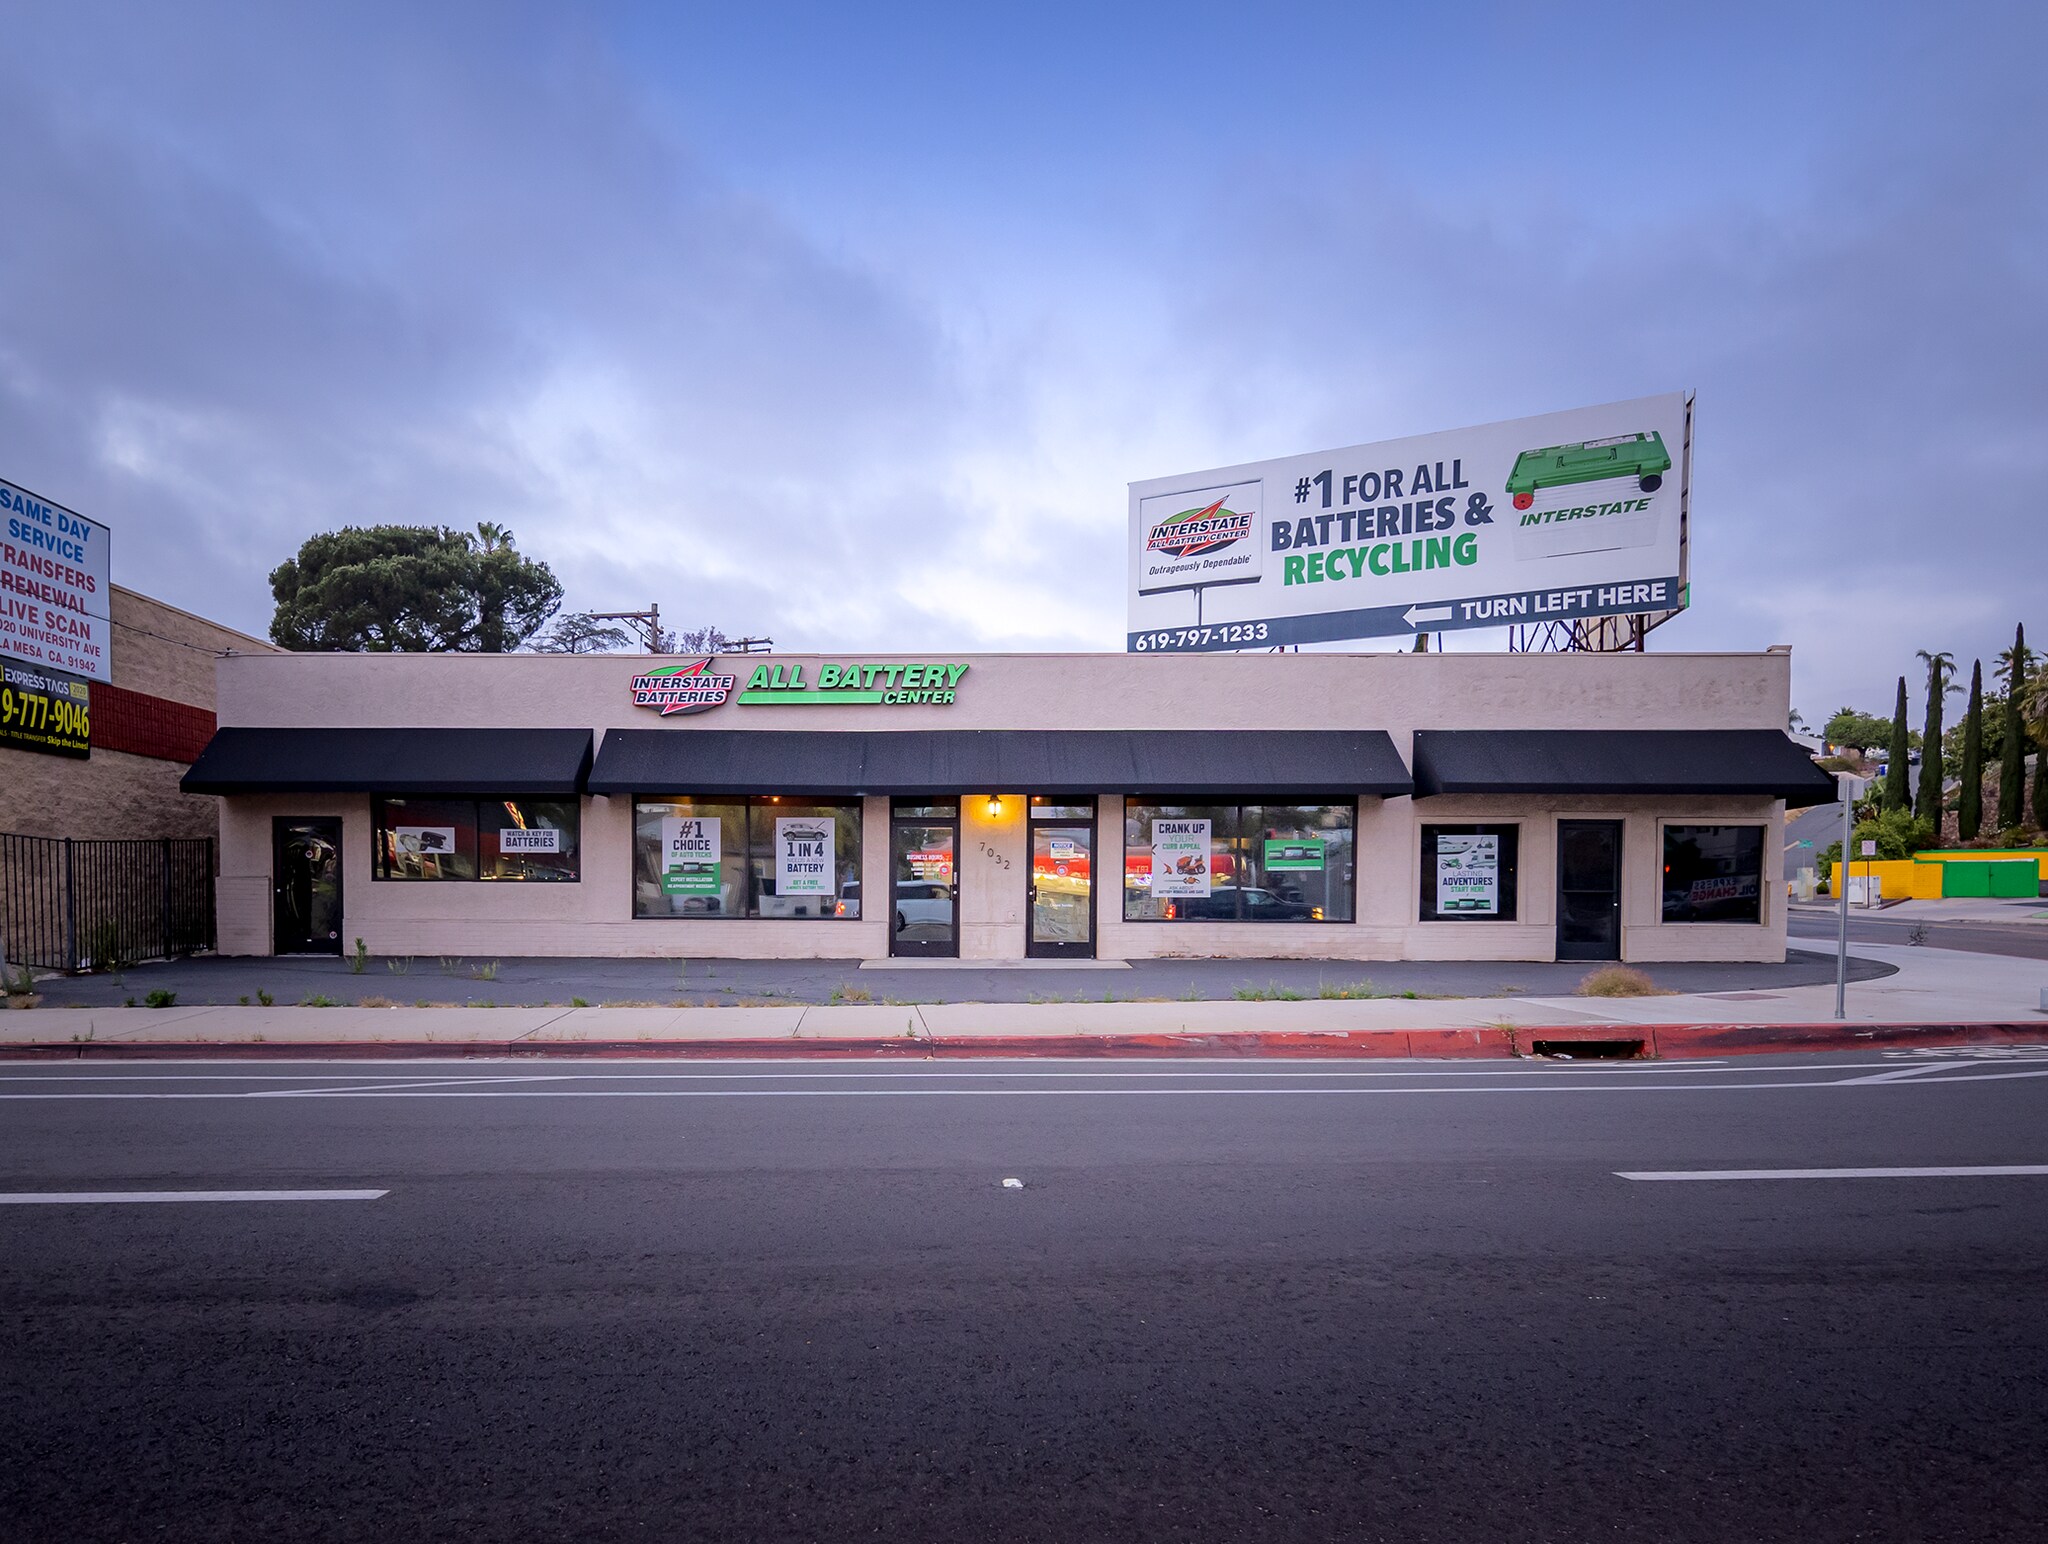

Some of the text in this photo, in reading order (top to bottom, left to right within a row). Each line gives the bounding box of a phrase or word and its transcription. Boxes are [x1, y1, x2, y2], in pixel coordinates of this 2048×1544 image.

[1294, 459, 1469, 508] #1 FOR ALL
[0, 488, 91, 542] SAME DAY
[1271, 492, 1494, 551] BATTERIES &
[1519, 498, 1652, 527] INTERSTATE
[1150, 530, 1248, 549] ALL BATTERY CENTER
[1151, 515, 1250, 539] INTERSTATE
[9, 518, 83, 564] SERVICE
[0, 542, 95, 594] RANSFERS
[1149, 556, 1251, 576] Outrageously Dependable
[1283, 532, 1478, 586] RECYCLING
[1, 569, 88, 617] RENEWAL
[1461, 582, 1667, 620] TURN LEFT HERE
[45, 610, 91, 640] SCAN
[1135, 623, 1268, 651] 619-797-1233
[20, 624, 80, 651] UNIVERSITY
[83, 643, 101, 657] AVE
[13, 640, 42, 658] MESA
[48, 650, 65, 665] CA.
[68, 656, 96, 673] 91942
[4, 668, 46, 690] EXPRESS
[45, 678, 70, 695] TAGS
[633, 677, 732, 689] INTERSTATE
[746, 664, 970, 690] ALL BATTERY
[636, 691, 725, 703] BATTERIES
[884, 690, 956, 705] CENTER
[47, 736, 61, 747] Skip
[62, 739, 72, 747] the
[506, 837, 554, 847] BATTERIES
[680, 821, 704, 838] #1
[1159, 824, 1205, 834] CRANK UP
[673, 840, 711, 850] CHOICE
[787, 842, 824, 857] 1 IN 4
[980, 842, 1010, 869] 7032
[787, 864, 824, 872] BATTERY
[1443, 877, 1493, 885] ADVENTURES
